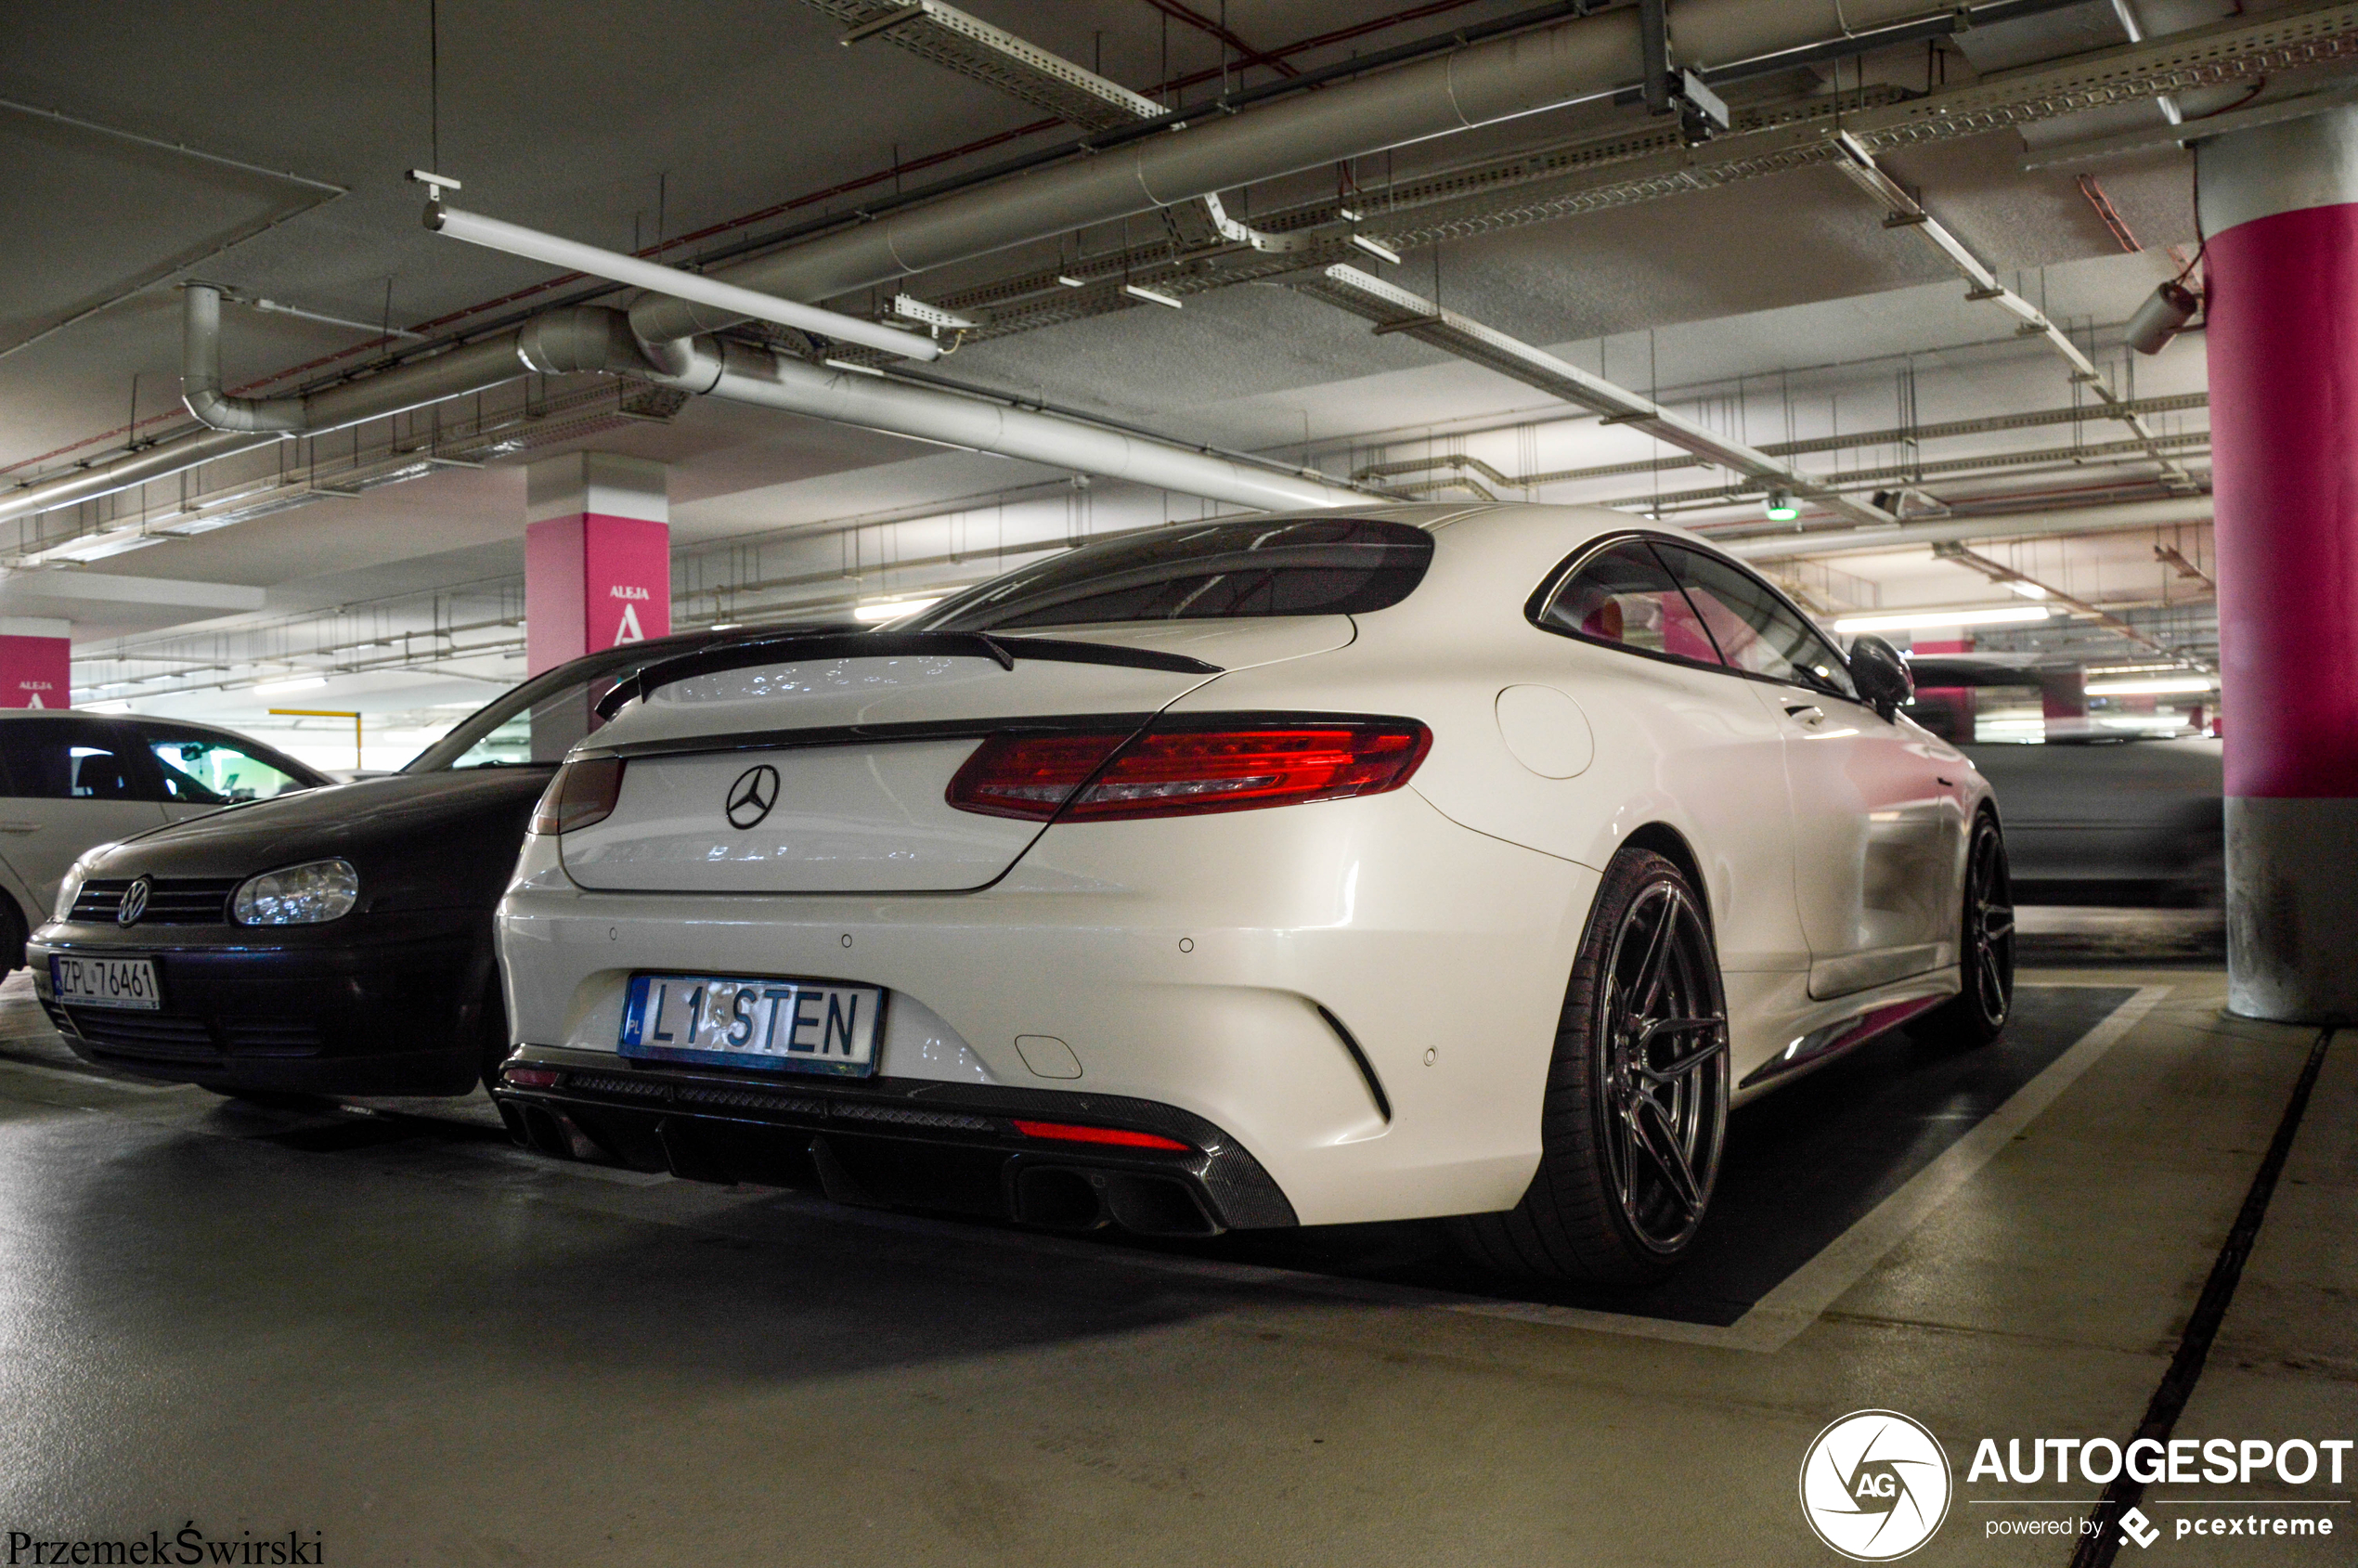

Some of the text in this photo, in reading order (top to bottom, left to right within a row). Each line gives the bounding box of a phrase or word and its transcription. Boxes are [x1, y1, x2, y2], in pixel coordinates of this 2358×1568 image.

[610, 586, 649, 600] ALEJA
[614, 603, 644, 647] A
[60, 960, 153, 998] ZPL 76461
[628, 1019, 641, 1034] PL
[727, 988, 858, 1056] STEN
